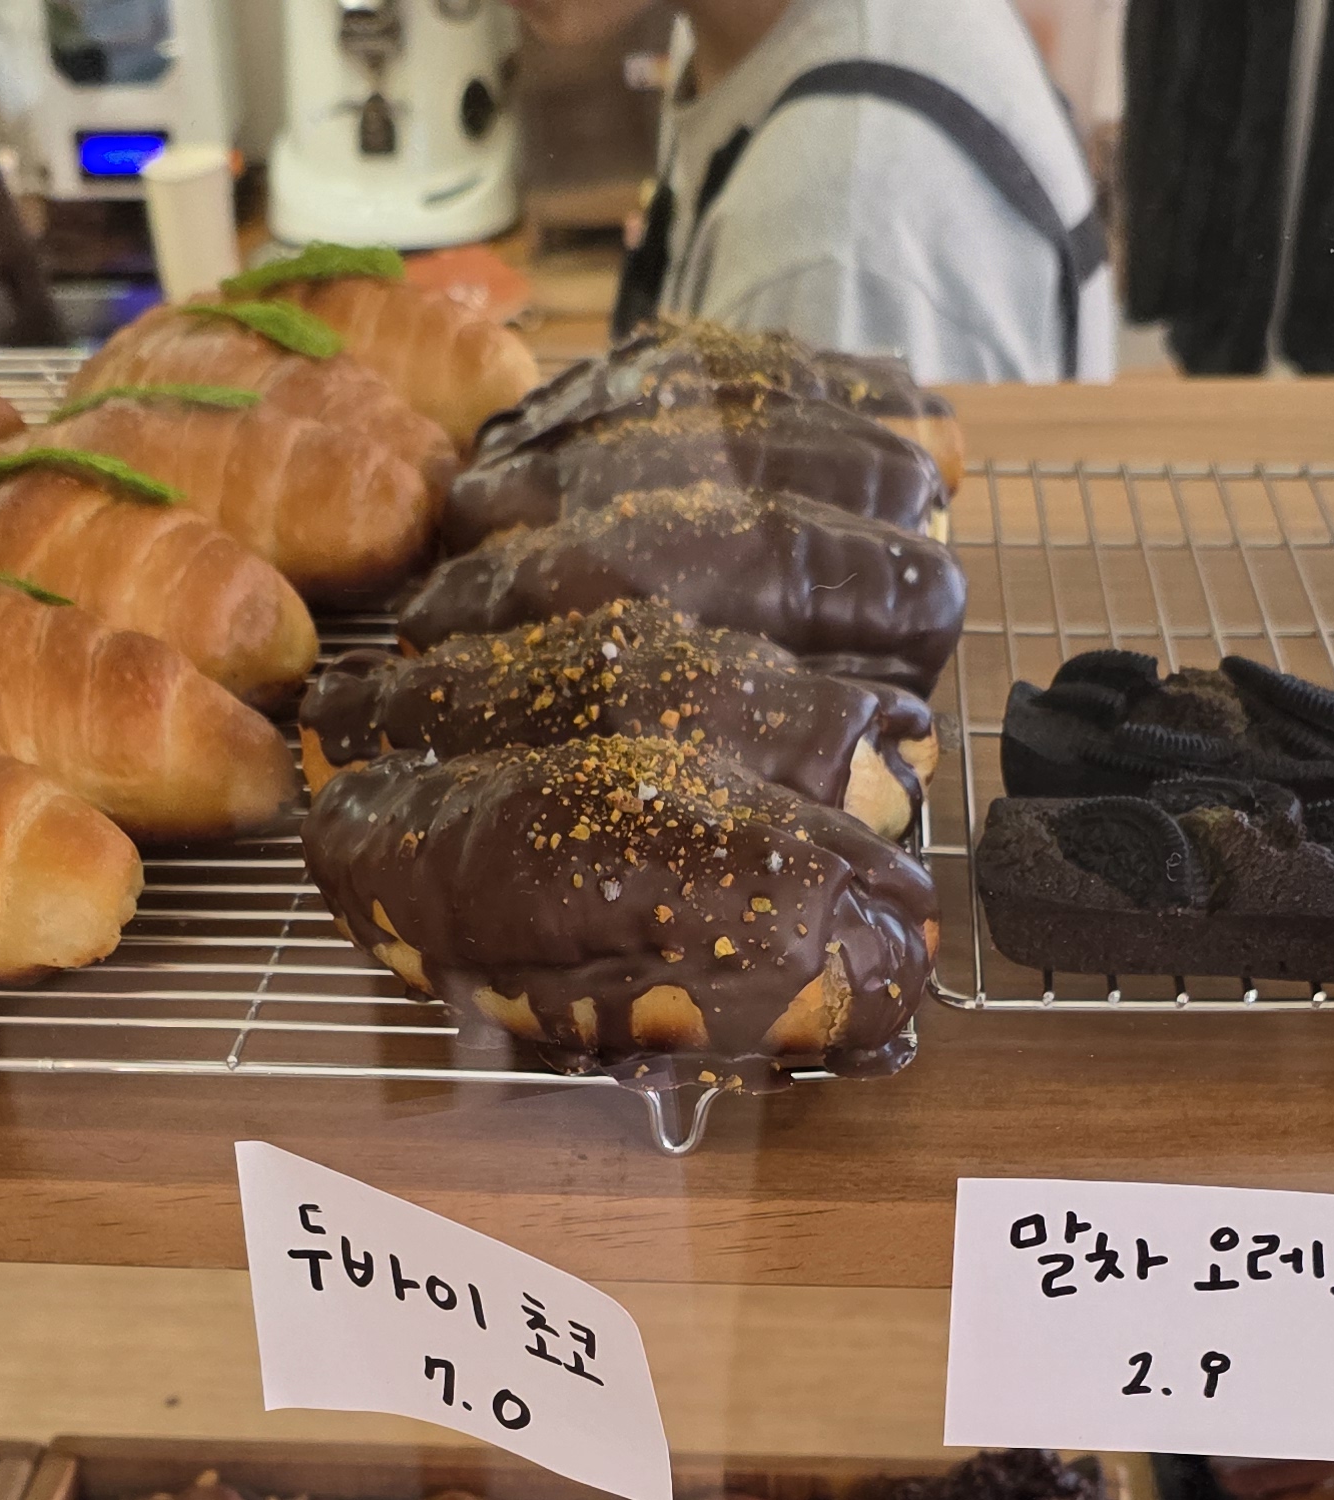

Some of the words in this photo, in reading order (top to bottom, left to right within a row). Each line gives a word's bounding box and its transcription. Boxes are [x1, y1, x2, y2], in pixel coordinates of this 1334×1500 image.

[286, 1202, 488, 1331] 두바이
[519, 1291, 606, 1388] 초코
[1008, 1209, 1170, 1299] 말차
[423, 1352, 532, 1431] 7.0
[1120, 1349, 1232, 1400] 2.9
